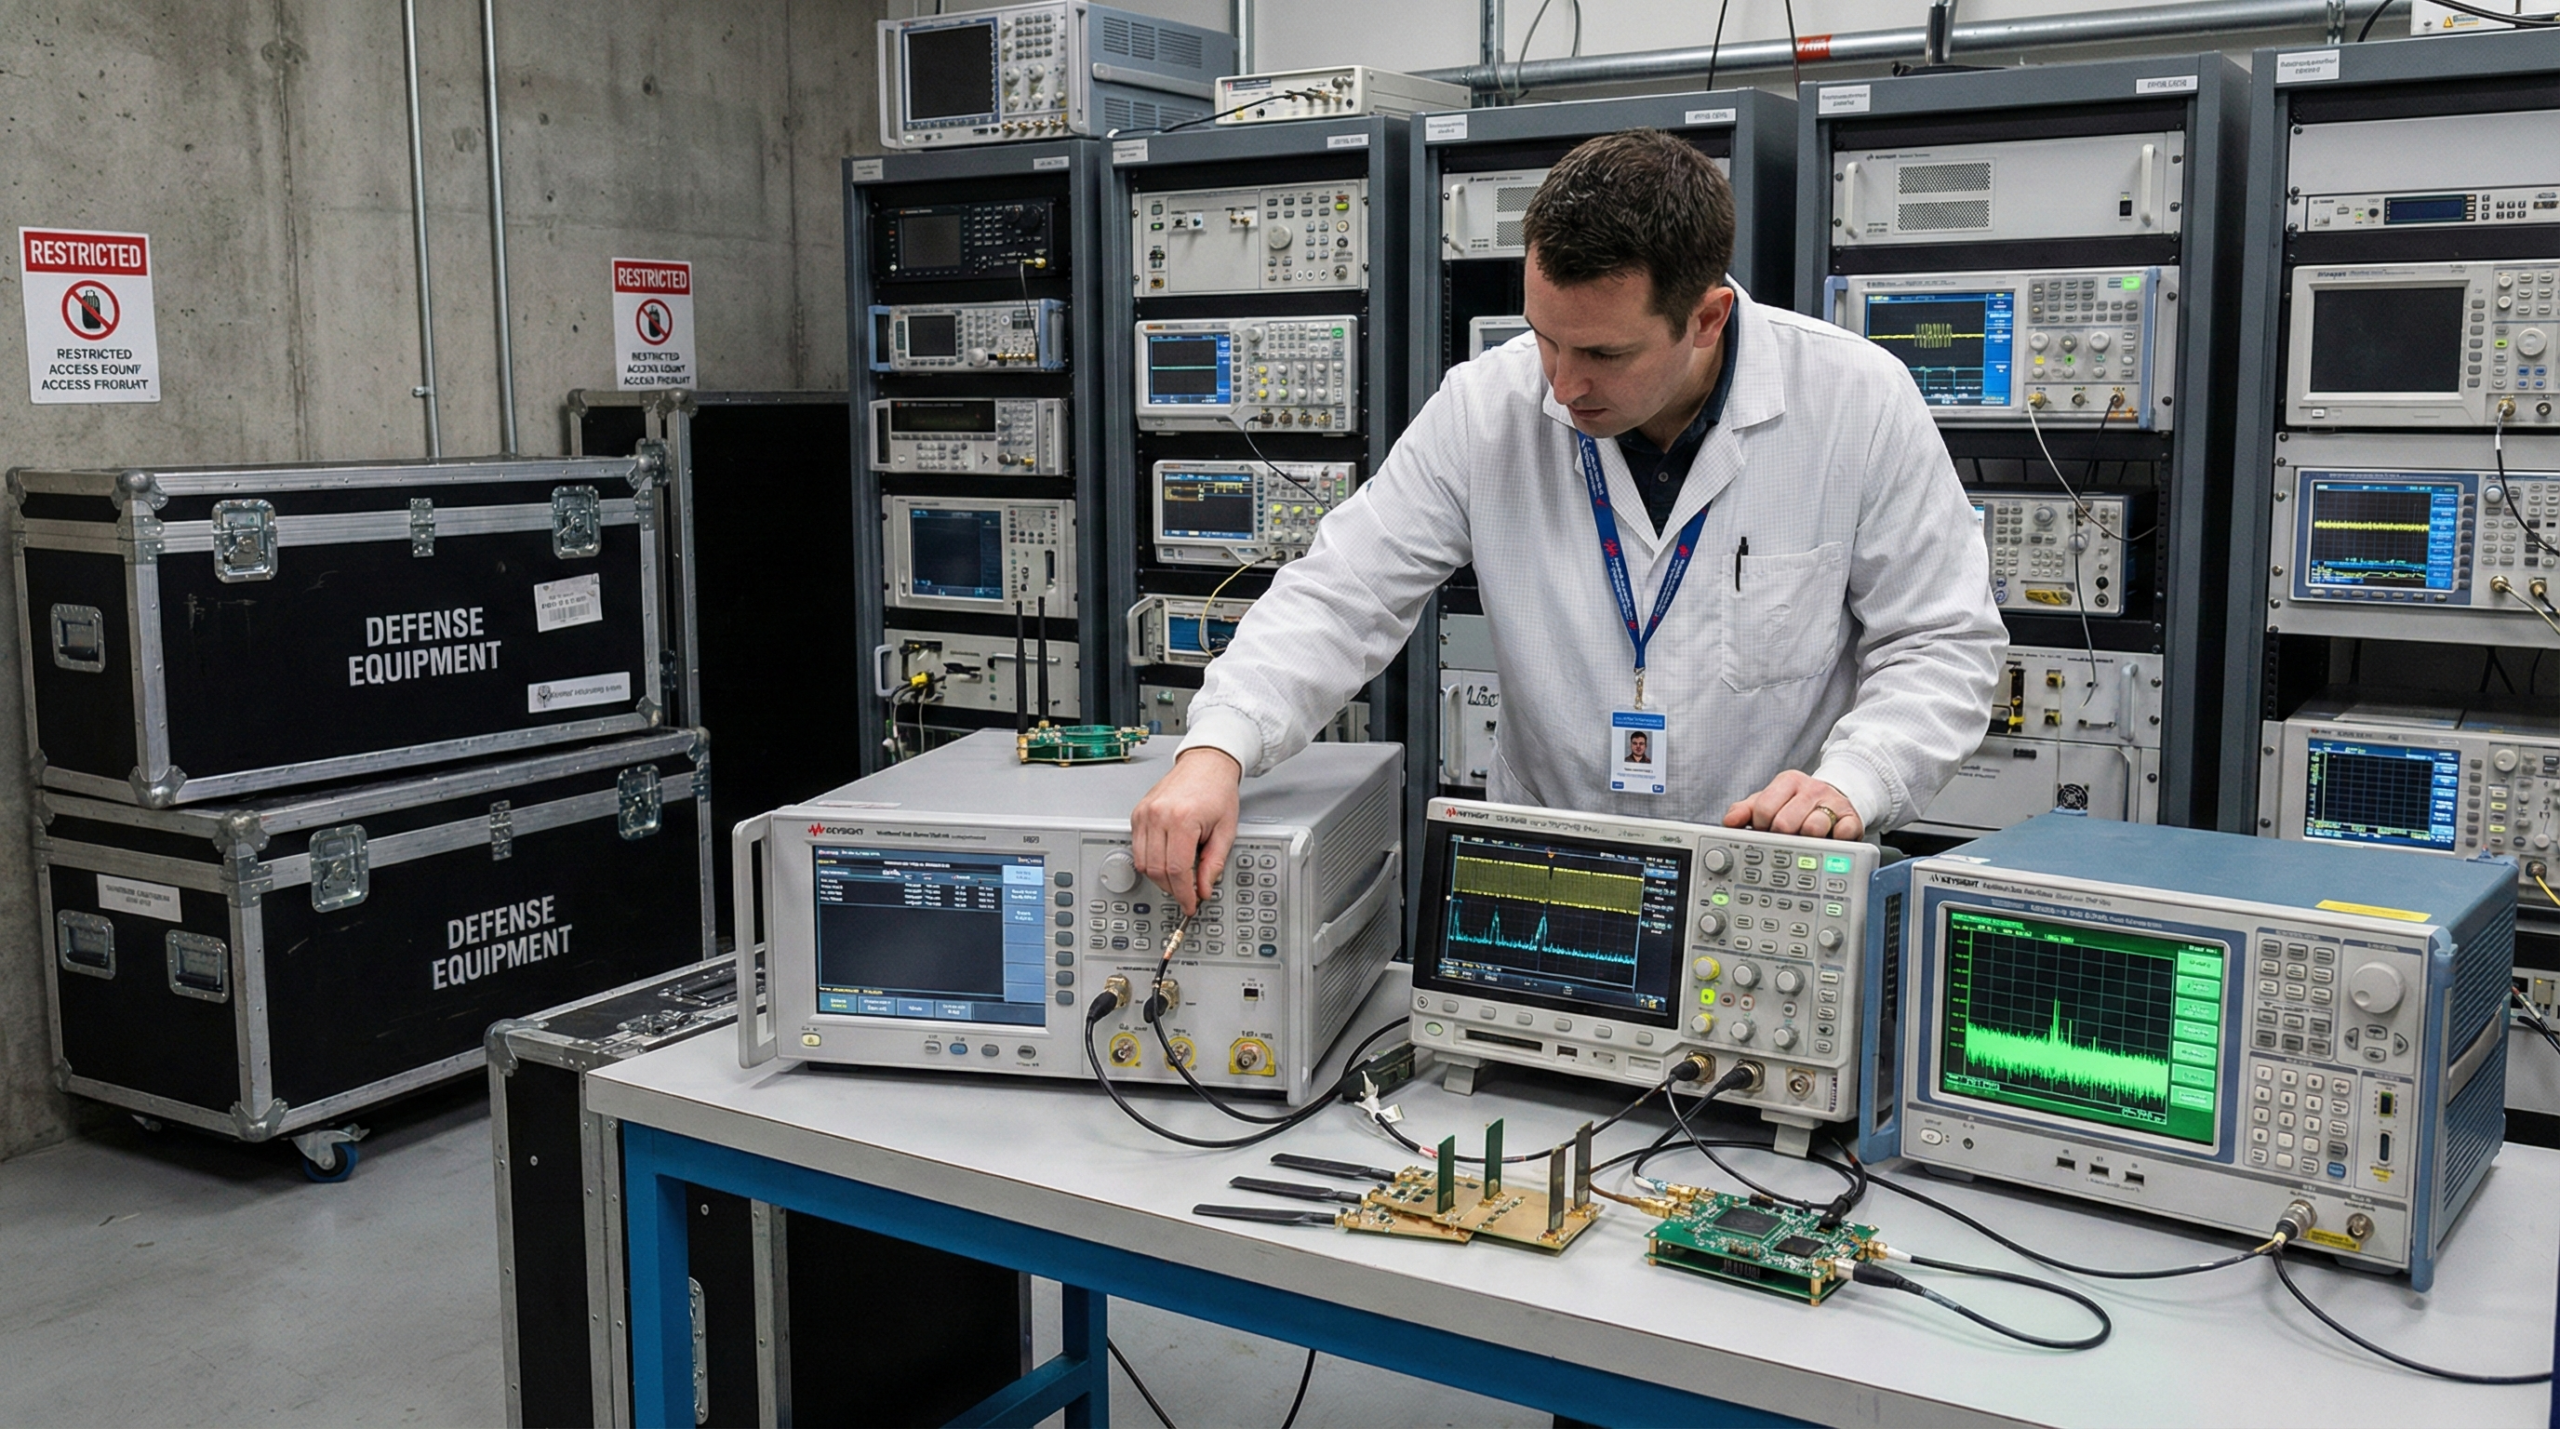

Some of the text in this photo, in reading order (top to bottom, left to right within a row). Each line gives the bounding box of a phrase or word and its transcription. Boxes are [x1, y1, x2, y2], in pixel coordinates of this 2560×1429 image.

[30, 239, 142, 269] RESTRICTED
[618, 267, 687, 289] RESTRICTED
[48, 363, 99, 375] ACCESS
[57, 348, 133, 360] RESTRICTED
[41, 379, 92, 391] ACCESS
[365, 606, 485, 648] DEFENSE
[348, 639, 502, 687] EQUIPMENT
[447, 894, 556, 950] DEFENSE
[432, 923, 573, 991] EQUIPMENT
